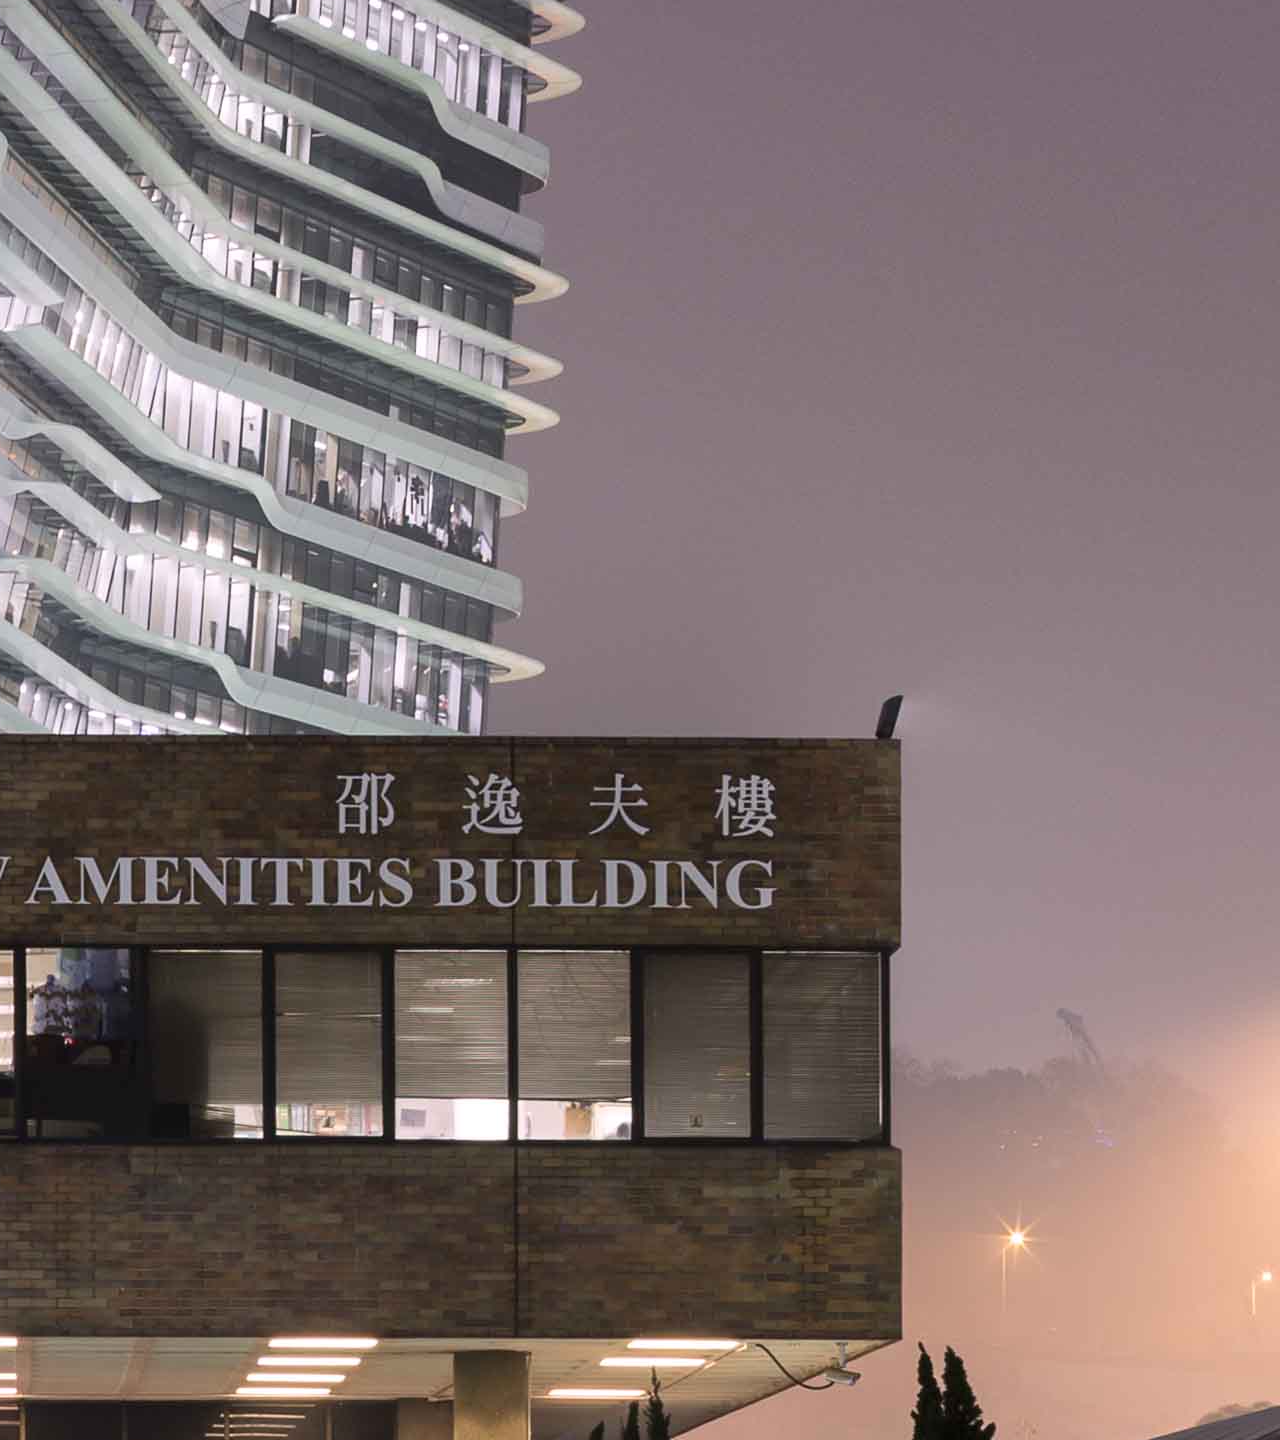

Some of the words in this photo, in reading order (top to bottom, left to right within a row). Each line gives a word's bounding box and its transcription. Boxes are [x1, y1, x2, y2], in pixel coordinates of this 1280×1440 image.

[336, 773, 777, 838] 邵逸夫樓
[23, 854, 414, 908] AMENITIES
[432, 857, 777, 910] BUILDING
